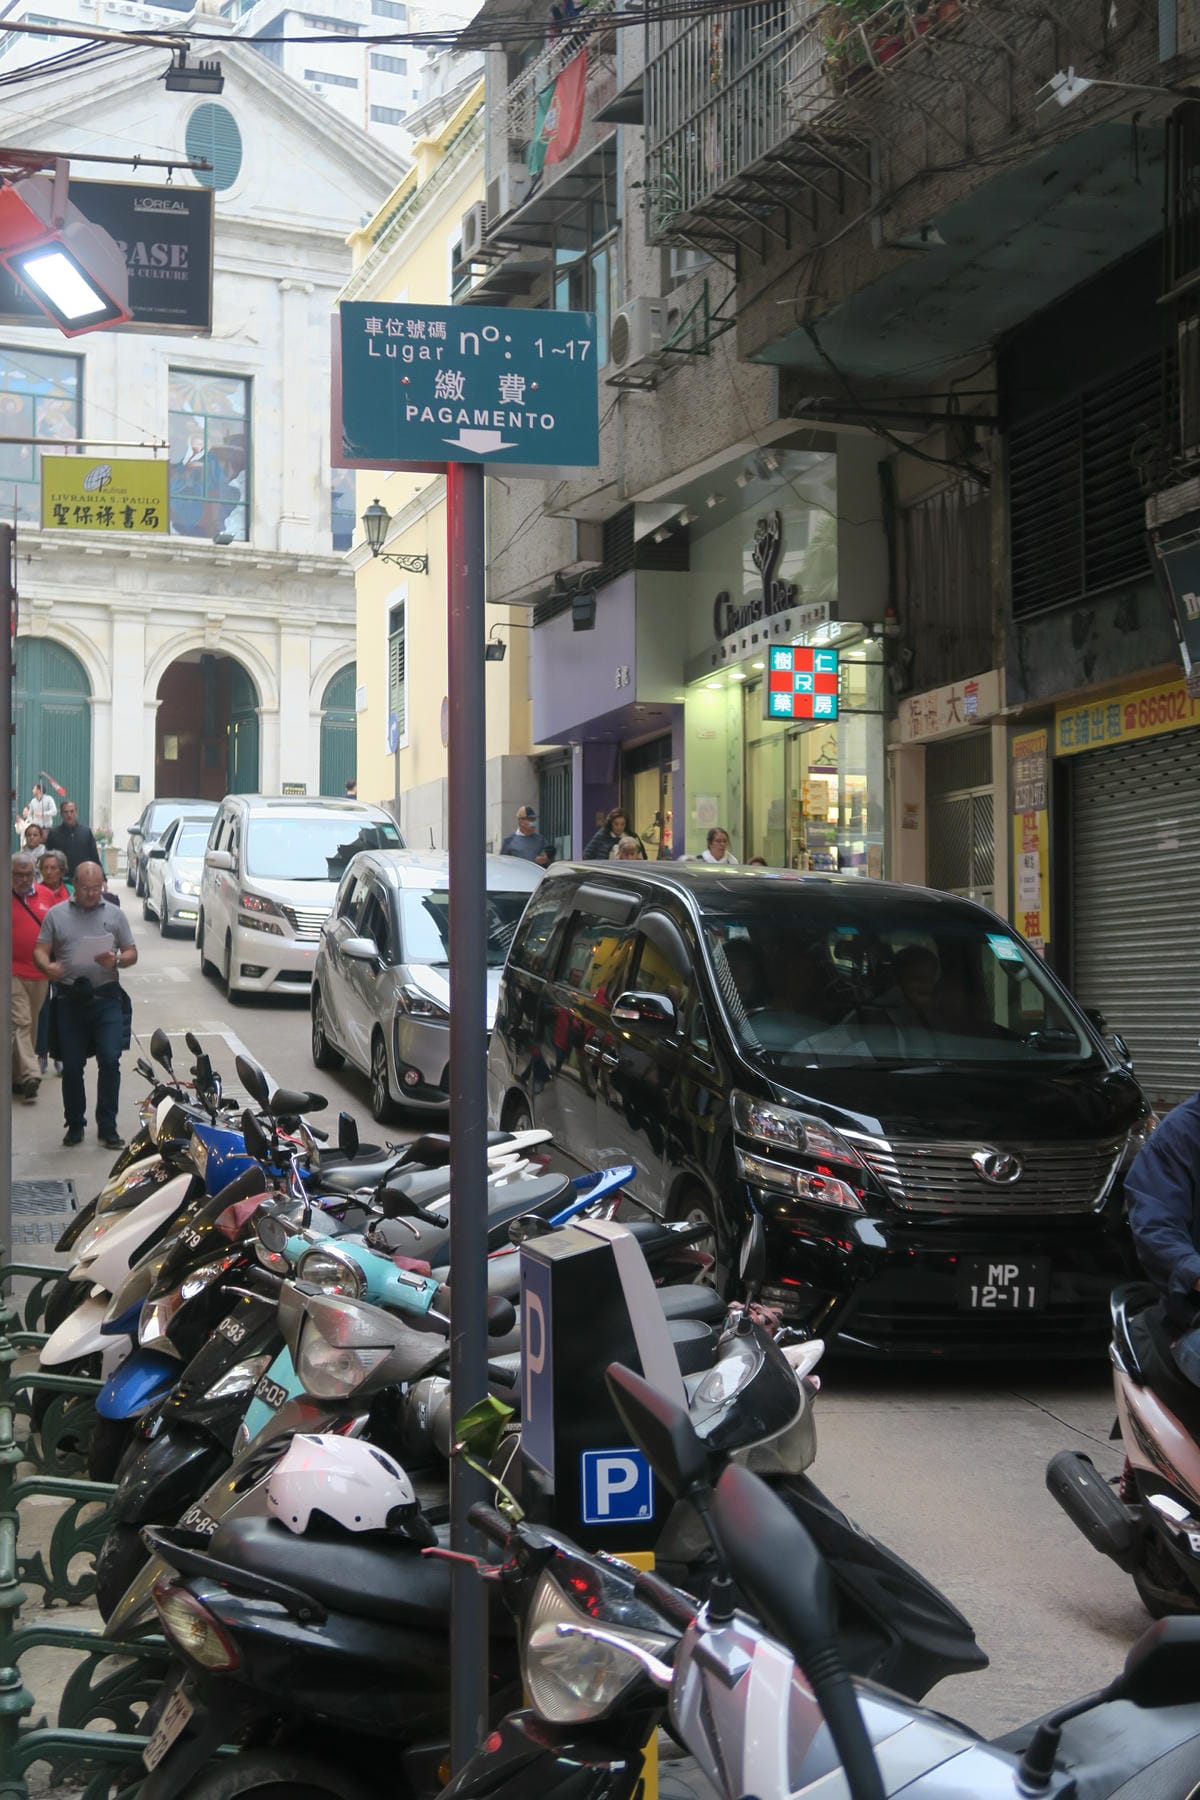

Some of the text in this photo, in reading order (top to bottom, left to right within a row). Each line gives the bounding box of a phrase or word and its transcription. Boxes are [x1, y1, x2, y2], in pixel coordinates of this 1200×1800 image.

[138, 269, 189, 281] CULTURE
[364, 317, 447, 341] 車位號碼
[368, 338, 444, 363] Lugar
[405, 404, 555, 430] PAGAMENTO
[51, 494, 107, 504] LIVRARIA
[122, 497, 161, 505] PAULO
[988, 1264, 1019, 1286] MP
[970, 1286, 1036, 1308] 12-11
[525, 1289, 546, 1422] P
[596, 1457, 639, 1515] P
